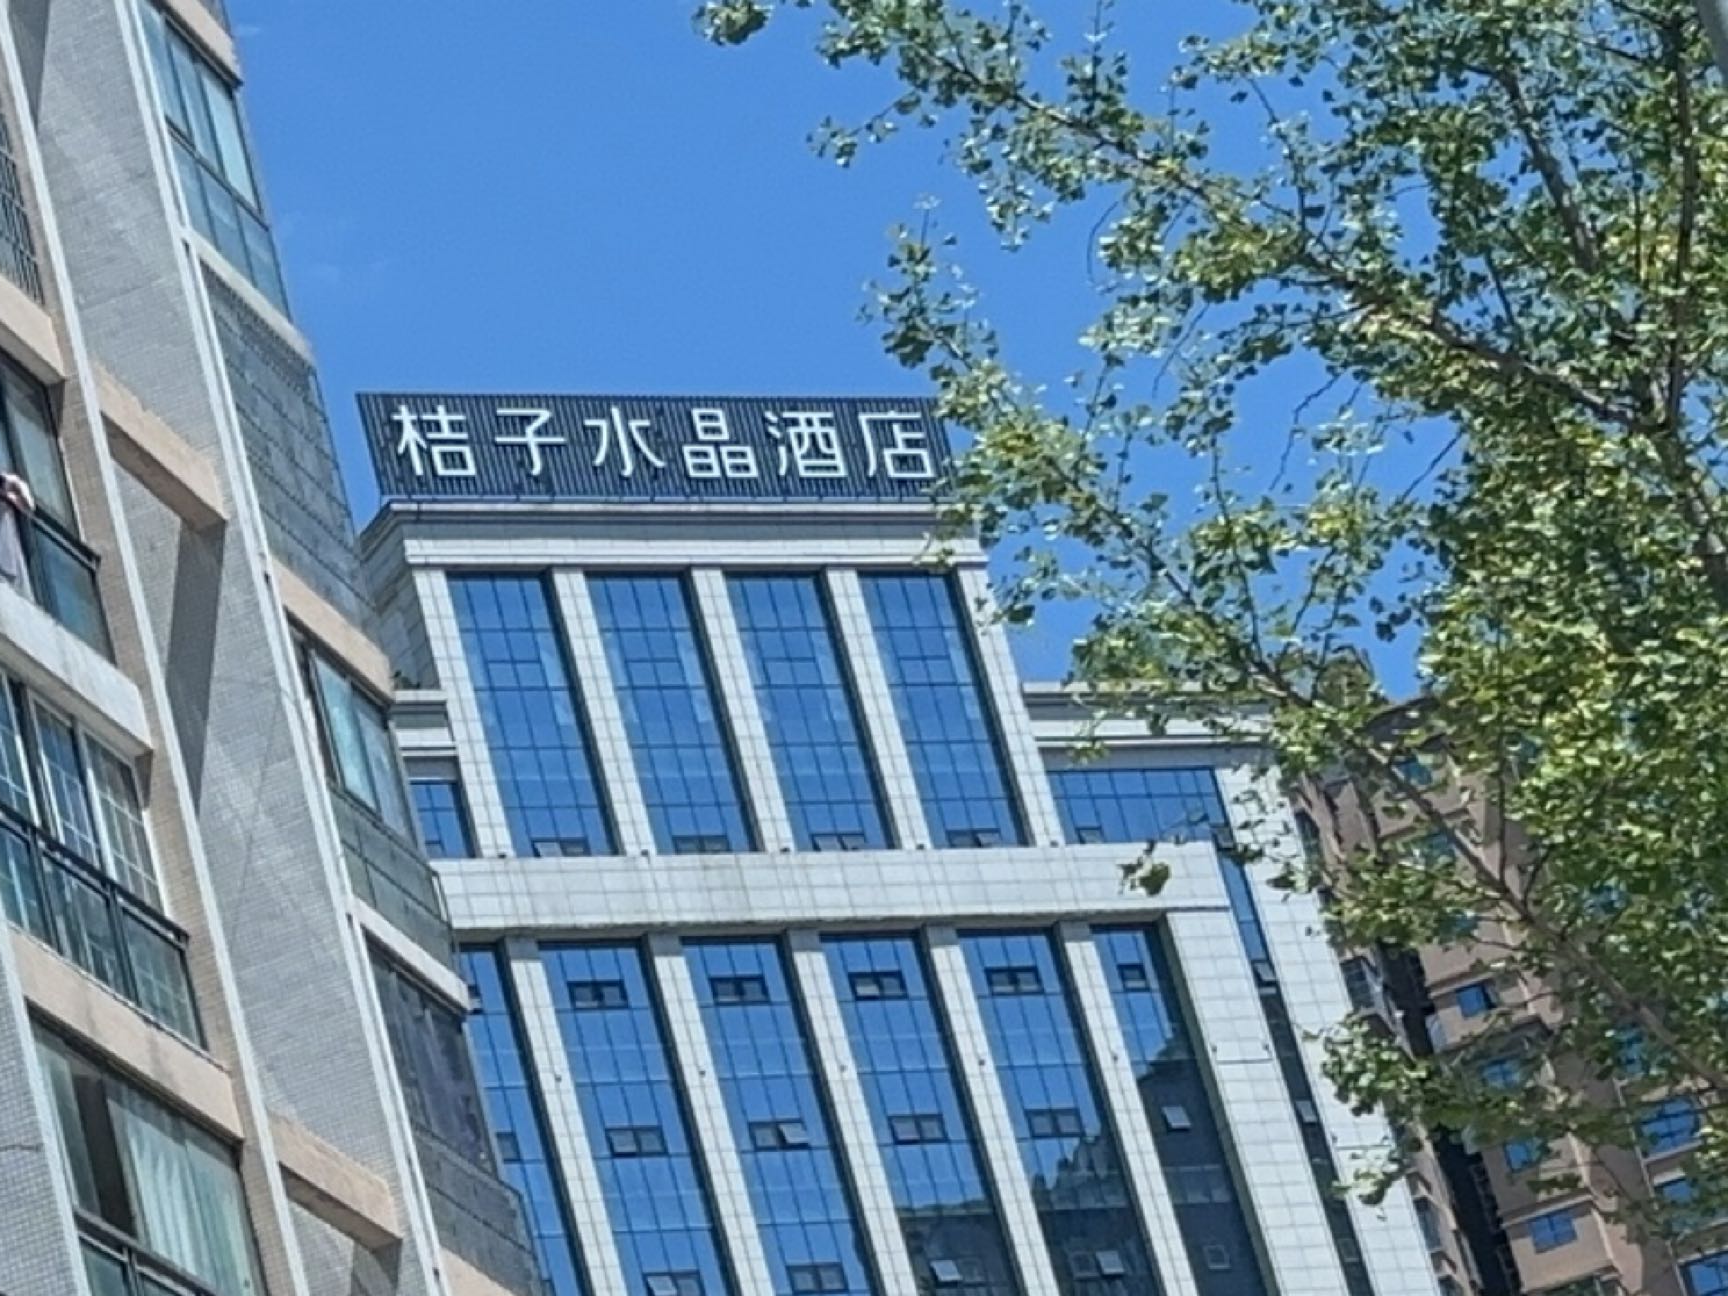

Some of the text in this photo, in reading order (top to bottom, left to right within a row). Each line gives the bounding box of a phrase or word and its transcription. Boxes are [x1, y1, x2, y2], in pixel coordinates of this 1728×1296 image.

[391, 404, 935, 479] 桔子水晶酒店
